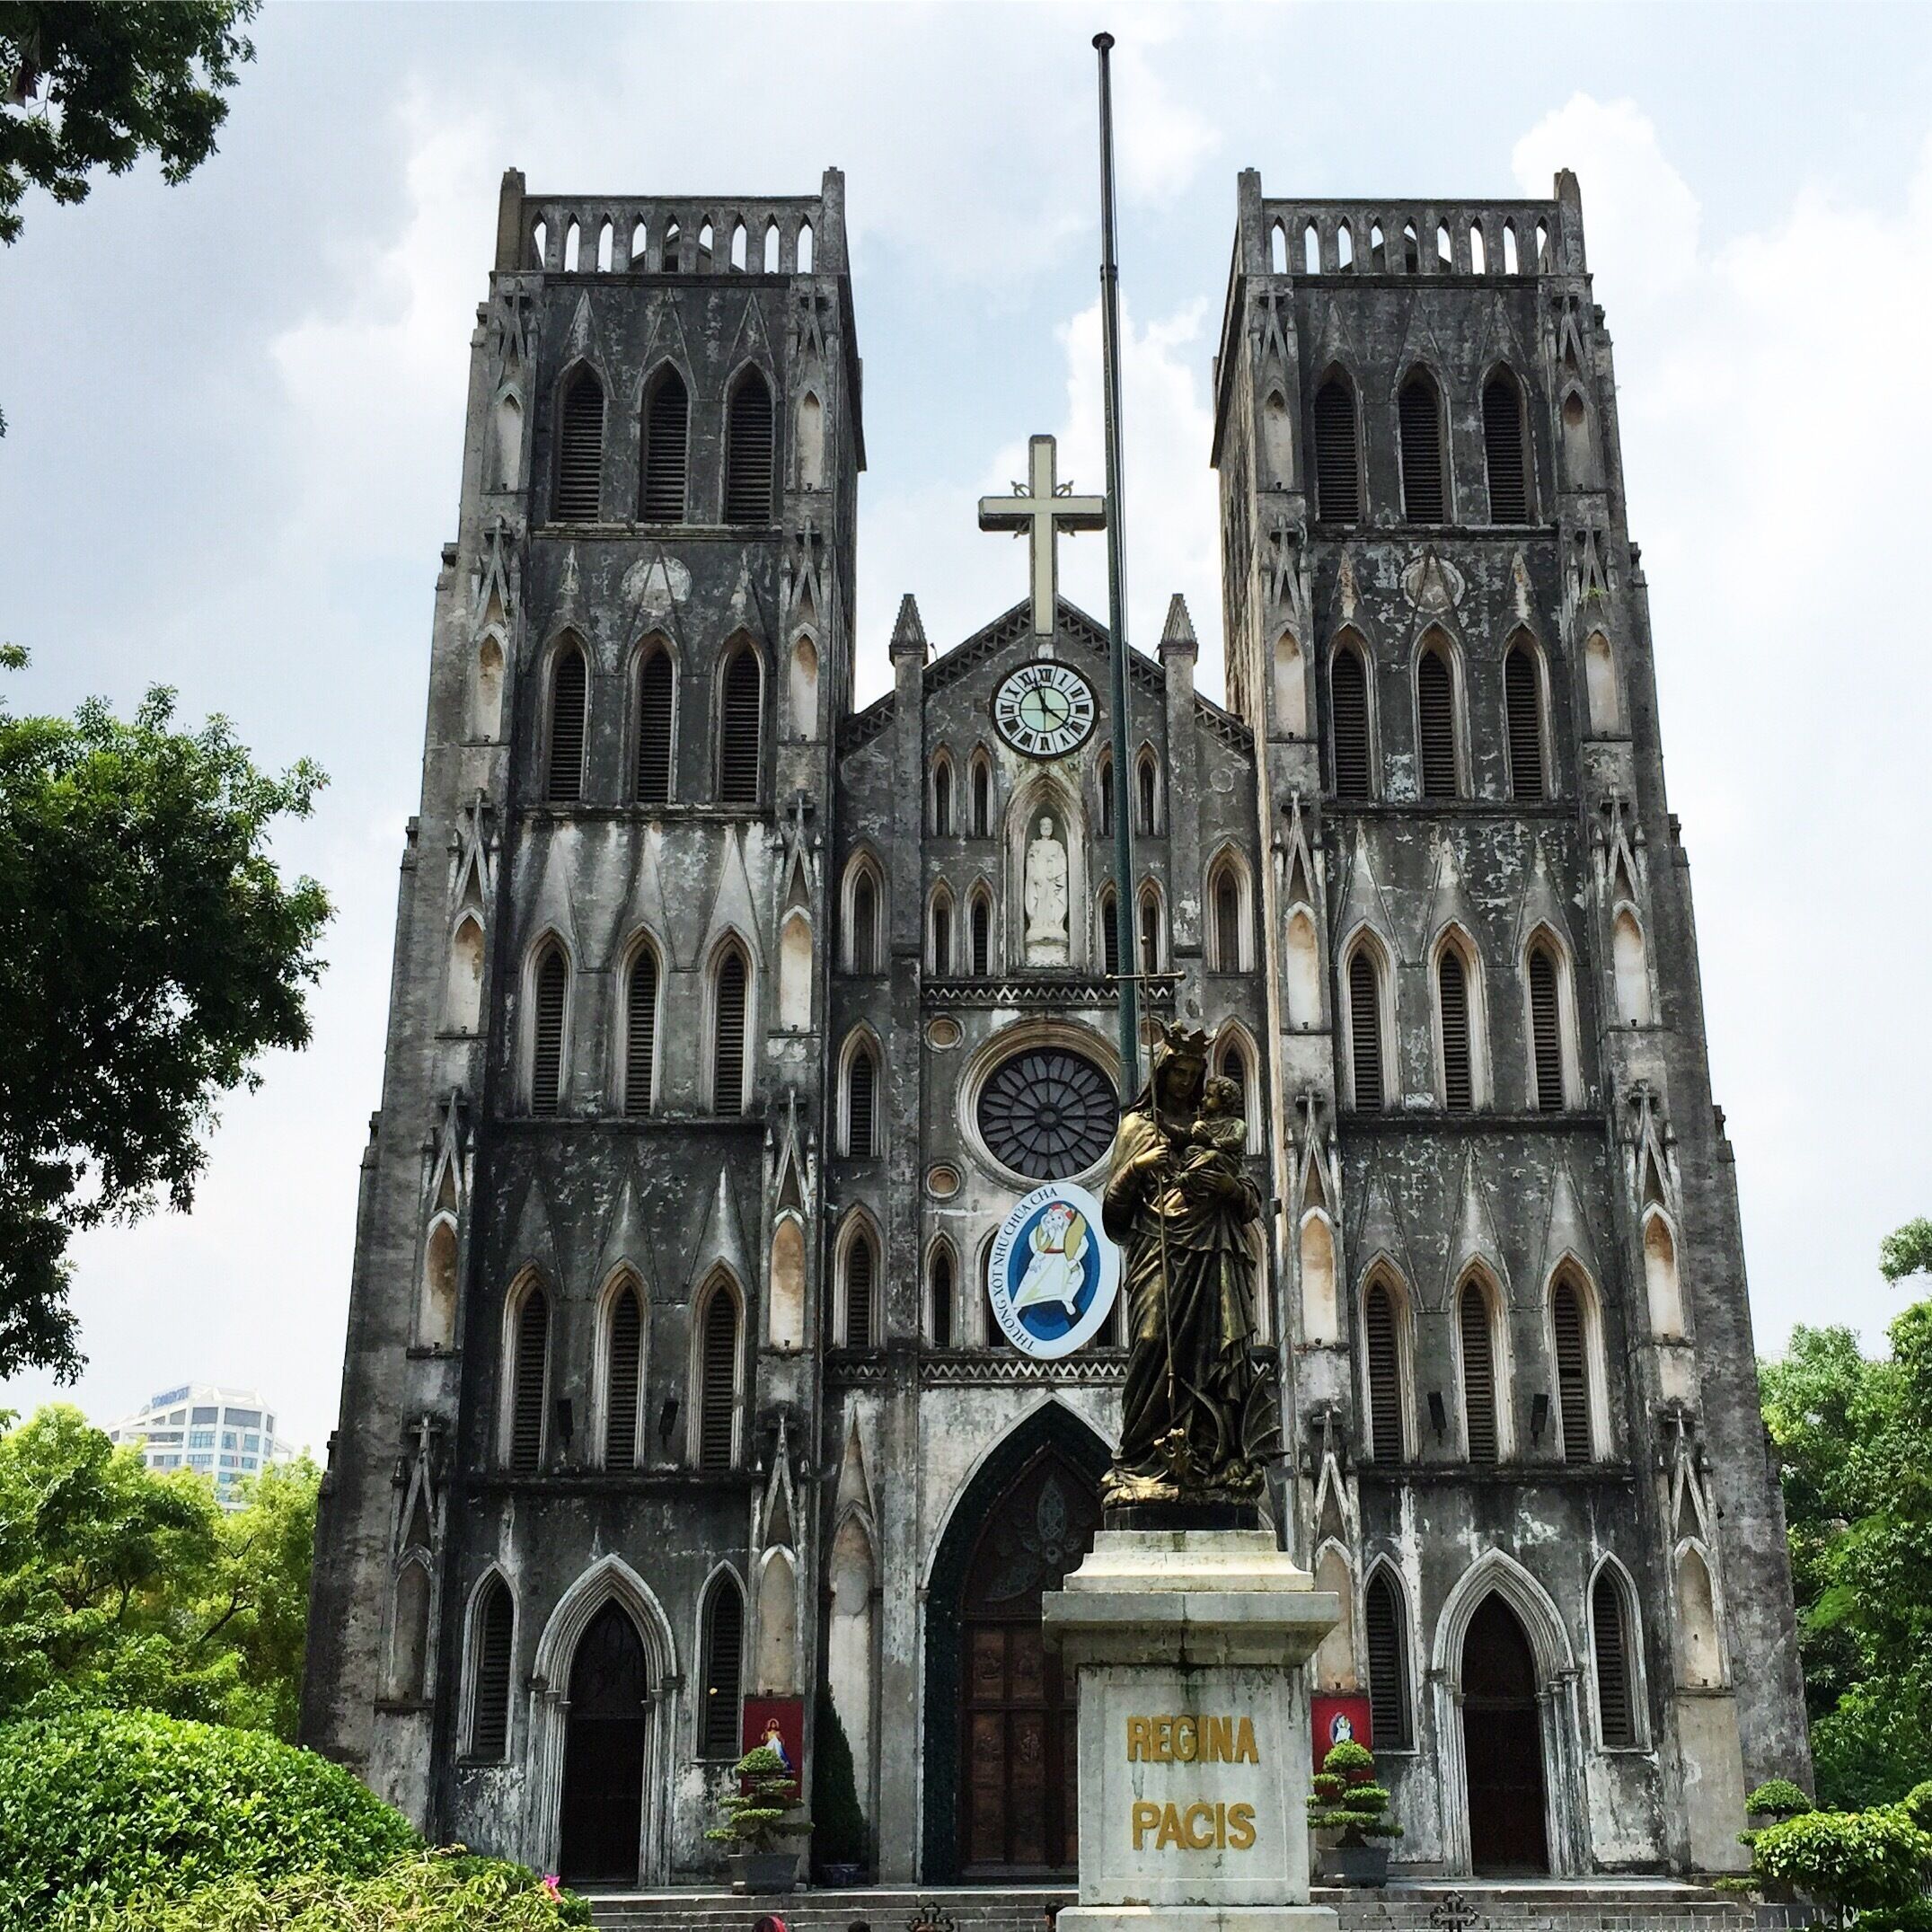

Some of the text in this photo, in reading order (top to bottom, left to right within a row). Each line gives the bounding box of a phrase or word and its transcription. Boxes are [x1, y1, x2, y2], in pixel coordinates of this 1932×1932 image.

[1018, 672, 1032, 686] XI
[1038, 668, 1053, 682] XII
[1058, 674, 1068, 686] I
[1005, 686, 1020, 698] X
[1070, 686, 1085, 699] II
[1040, 737, 1050, 750] VI
[1060, 734, 1071, 746] V
[1029, 1187, 1059, 1205] CHA
[992, 1235, 1010, 1266] NHƯ
[990, 1269, 1005, 1297] XÓT
[995, 1300, 1035, 1352] THƯƠNG
[1127, 1714, 1259, 1764] REGINA
[1132, 1801, 1257, 1851] PACIS
